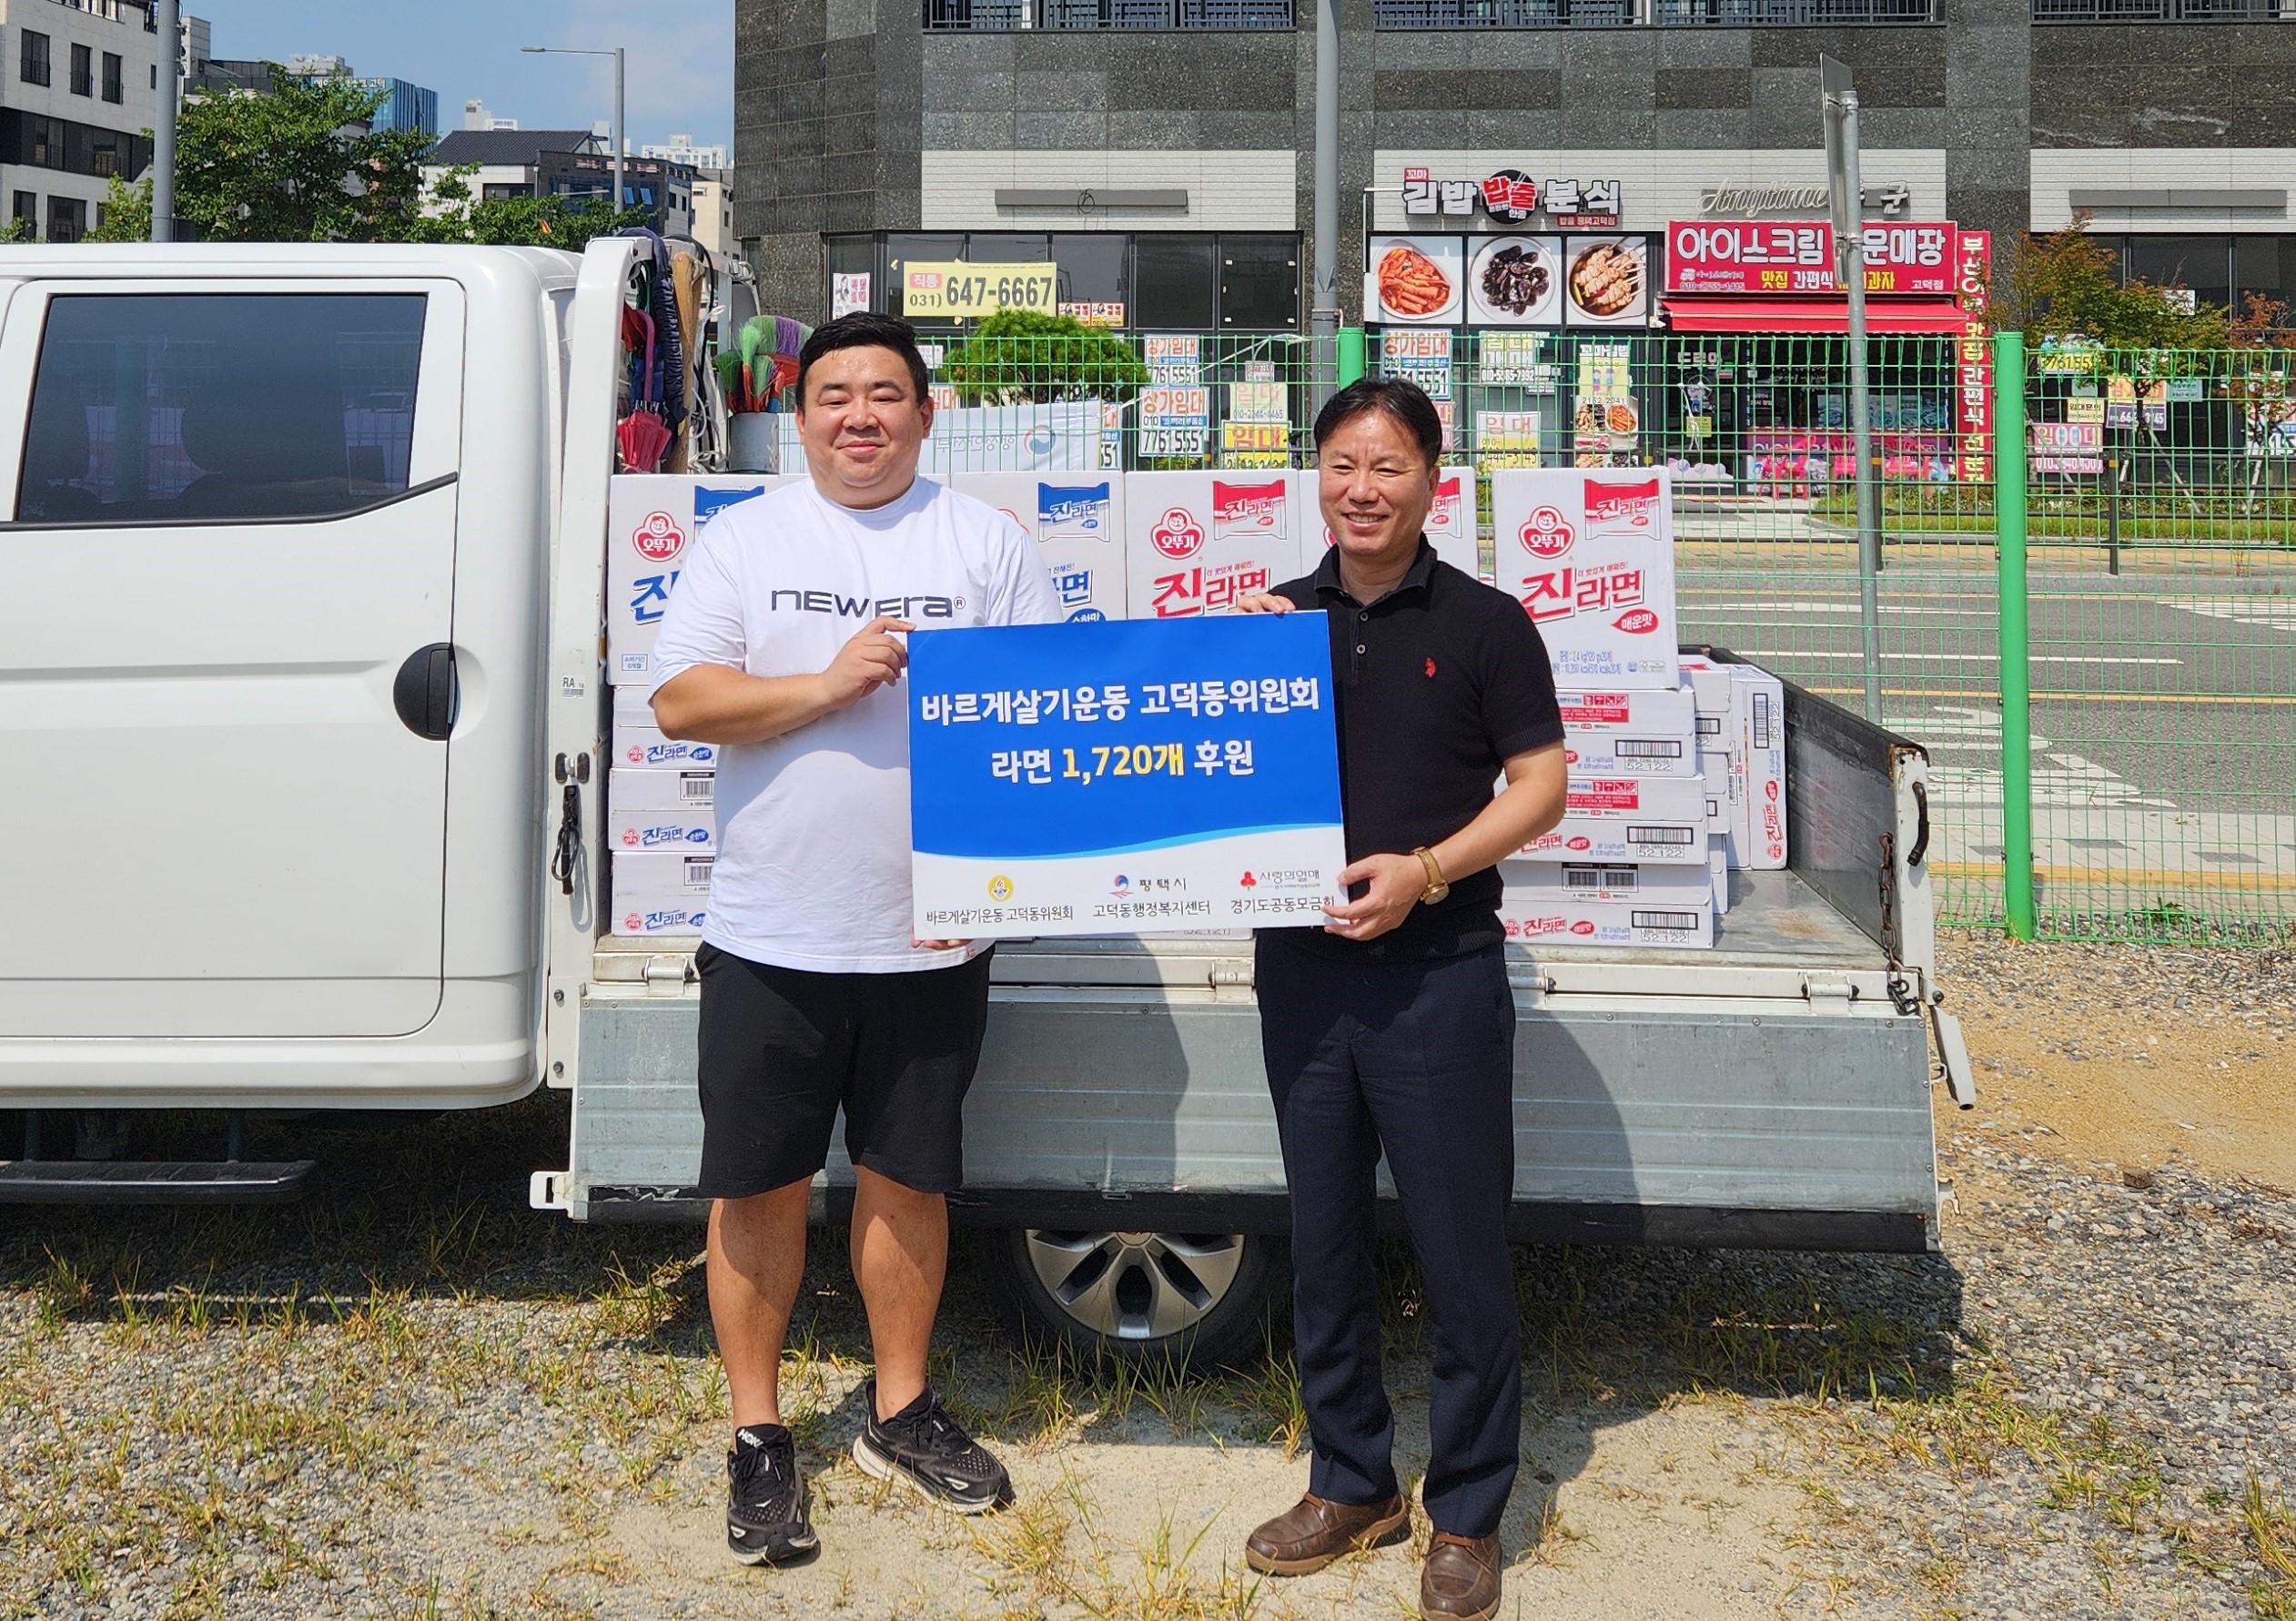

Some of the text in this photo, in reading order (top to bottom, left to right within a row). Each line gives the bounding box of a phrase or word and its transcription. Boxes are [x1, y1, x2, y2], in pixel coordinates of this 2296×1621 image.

[1405, 169, 1428, 180] 꼬마
[1402, 176, 1621, 215] 김밥 밥줄 분식
[1697, 177, 1828, 218] Anytime
[1676, 227, 1947, 266] 아이스크림 문매장
[912, 274, 939, 289] 직통
[1762, 270, 1788, 289] 맛집
[1793, 270, 1834, 289] 간편식
[1911, 279, 1944, 290] 고덕점
[909, 276, 1053, 308] 031) 647-6667
[1148, 338, 1196, 355] 상가임대
[1384, 331, 1448, 356] 상가임대
[1483, 333, 1533, 350] 임대
[1143, 391, 1205, 414] 상가임대
[1963, 367, 1986, 426] 간편식
[1143, 416, 1159, 426] 010
[1486, 416, 1531, 435] 임대
[1231, 426, 1281, 450] 임대
[1049, 499, 1098, 524] 진라면
[1225, 499, 1274, 522] 진라면
[1597, 497, 1649, 520] 진라면
[642, 538, 675, 552] 오뚜기
[1160, 534, 1196, 550] 오뚜기
[1530, 533, 1565, 549] 오뚜기
[1151, 567, 1270, 619] 진라면
[1522, 567, 1645, 624] 진라면
[1621, 613, 1654, 631] 매운맛
[562, 676, 575, 688] RA
[921, 676, 1320, 727] 바르게살기운동 고덕동위원회
[646, 745, 688, 765] 진라면
[991, 740, 1255, 786] 라면 1,720개 후원
[1626, 763, 1672, 772] 52 122
[642, 826, 684, 847] 진라면
[1638, 848, 1683, 858] 52 122
[1259, 869, 1320, 885] 사랑의열매
[925, 904, 1074, 926] 바르게살기운동 고덕동위원회
[1092, 899, 1211, 920] 고덕동행정복지센터
[1230, 896, 1335, 915] 경기도공동모금회
[644, 911, 687, 932] 진라면
[1523, 917, 1568, 938] 진라면
[1642, 934, 1687, 943] 52 122
